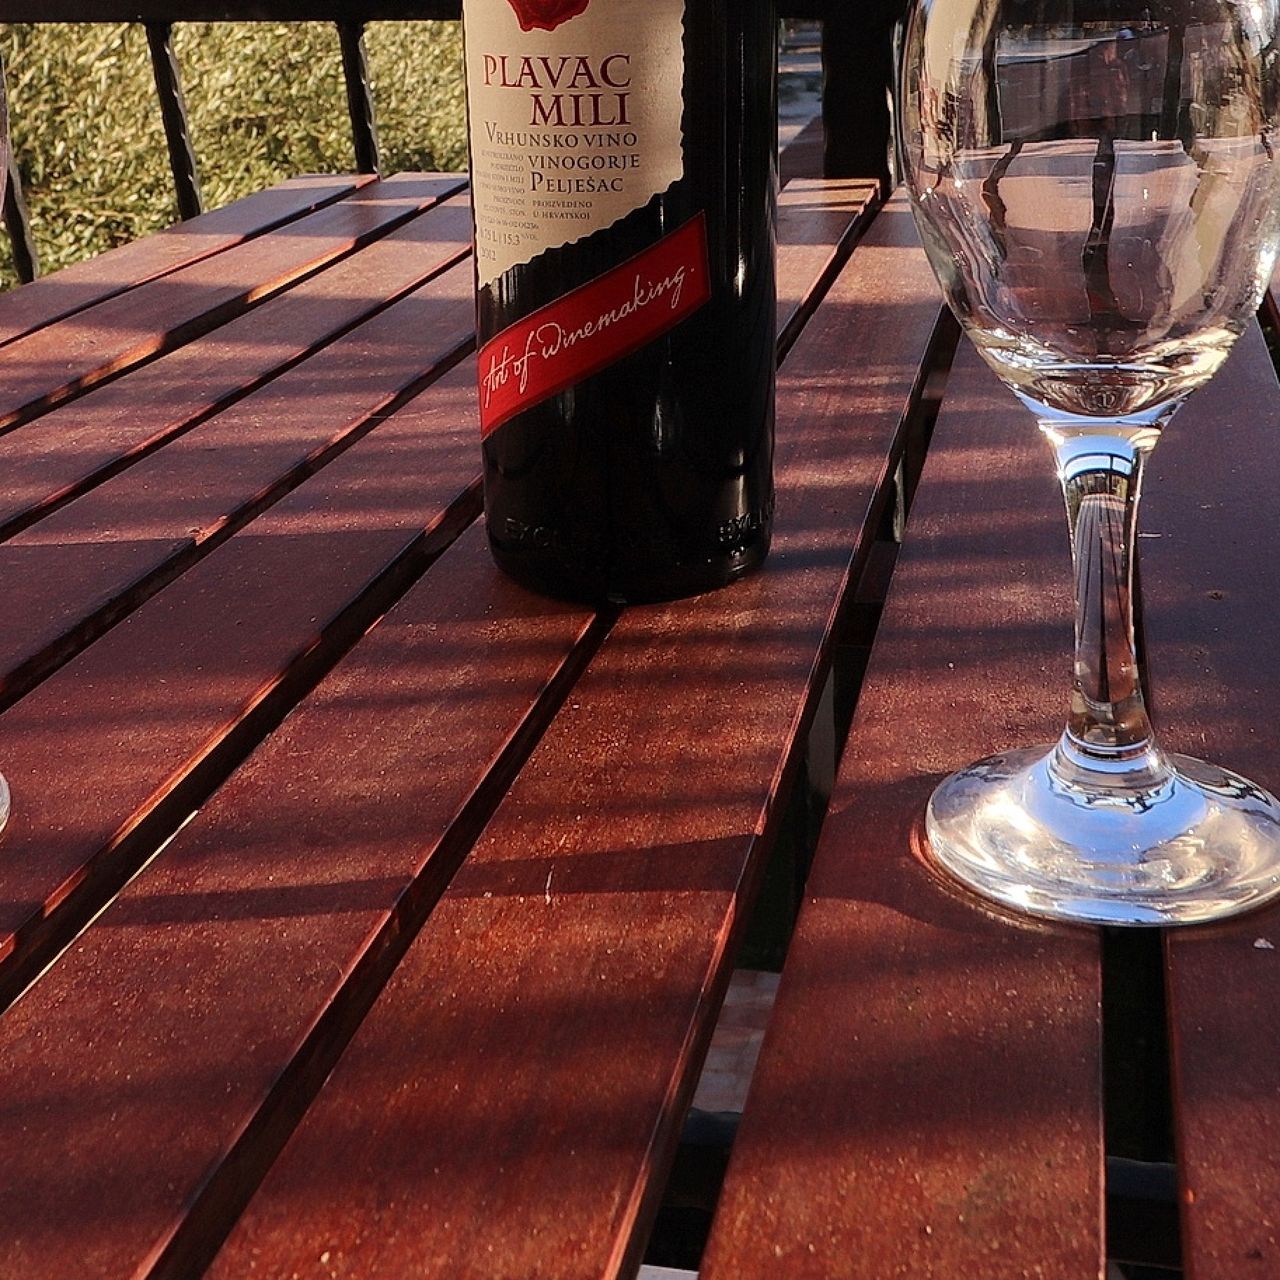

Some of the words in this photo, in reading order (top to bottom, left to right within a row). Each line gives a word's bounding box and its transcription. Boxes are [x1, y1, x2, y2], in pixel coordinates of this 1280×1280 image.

[482, 54, 631, 89] PLAVAC
[529, 91, 631, 126] MILI
[582, 132, 638, 148] VINO
[528, 154, 640, 170] VINOGORJE
[483, 345, 515, 408] Art
[512, 330, 537, 394] of
